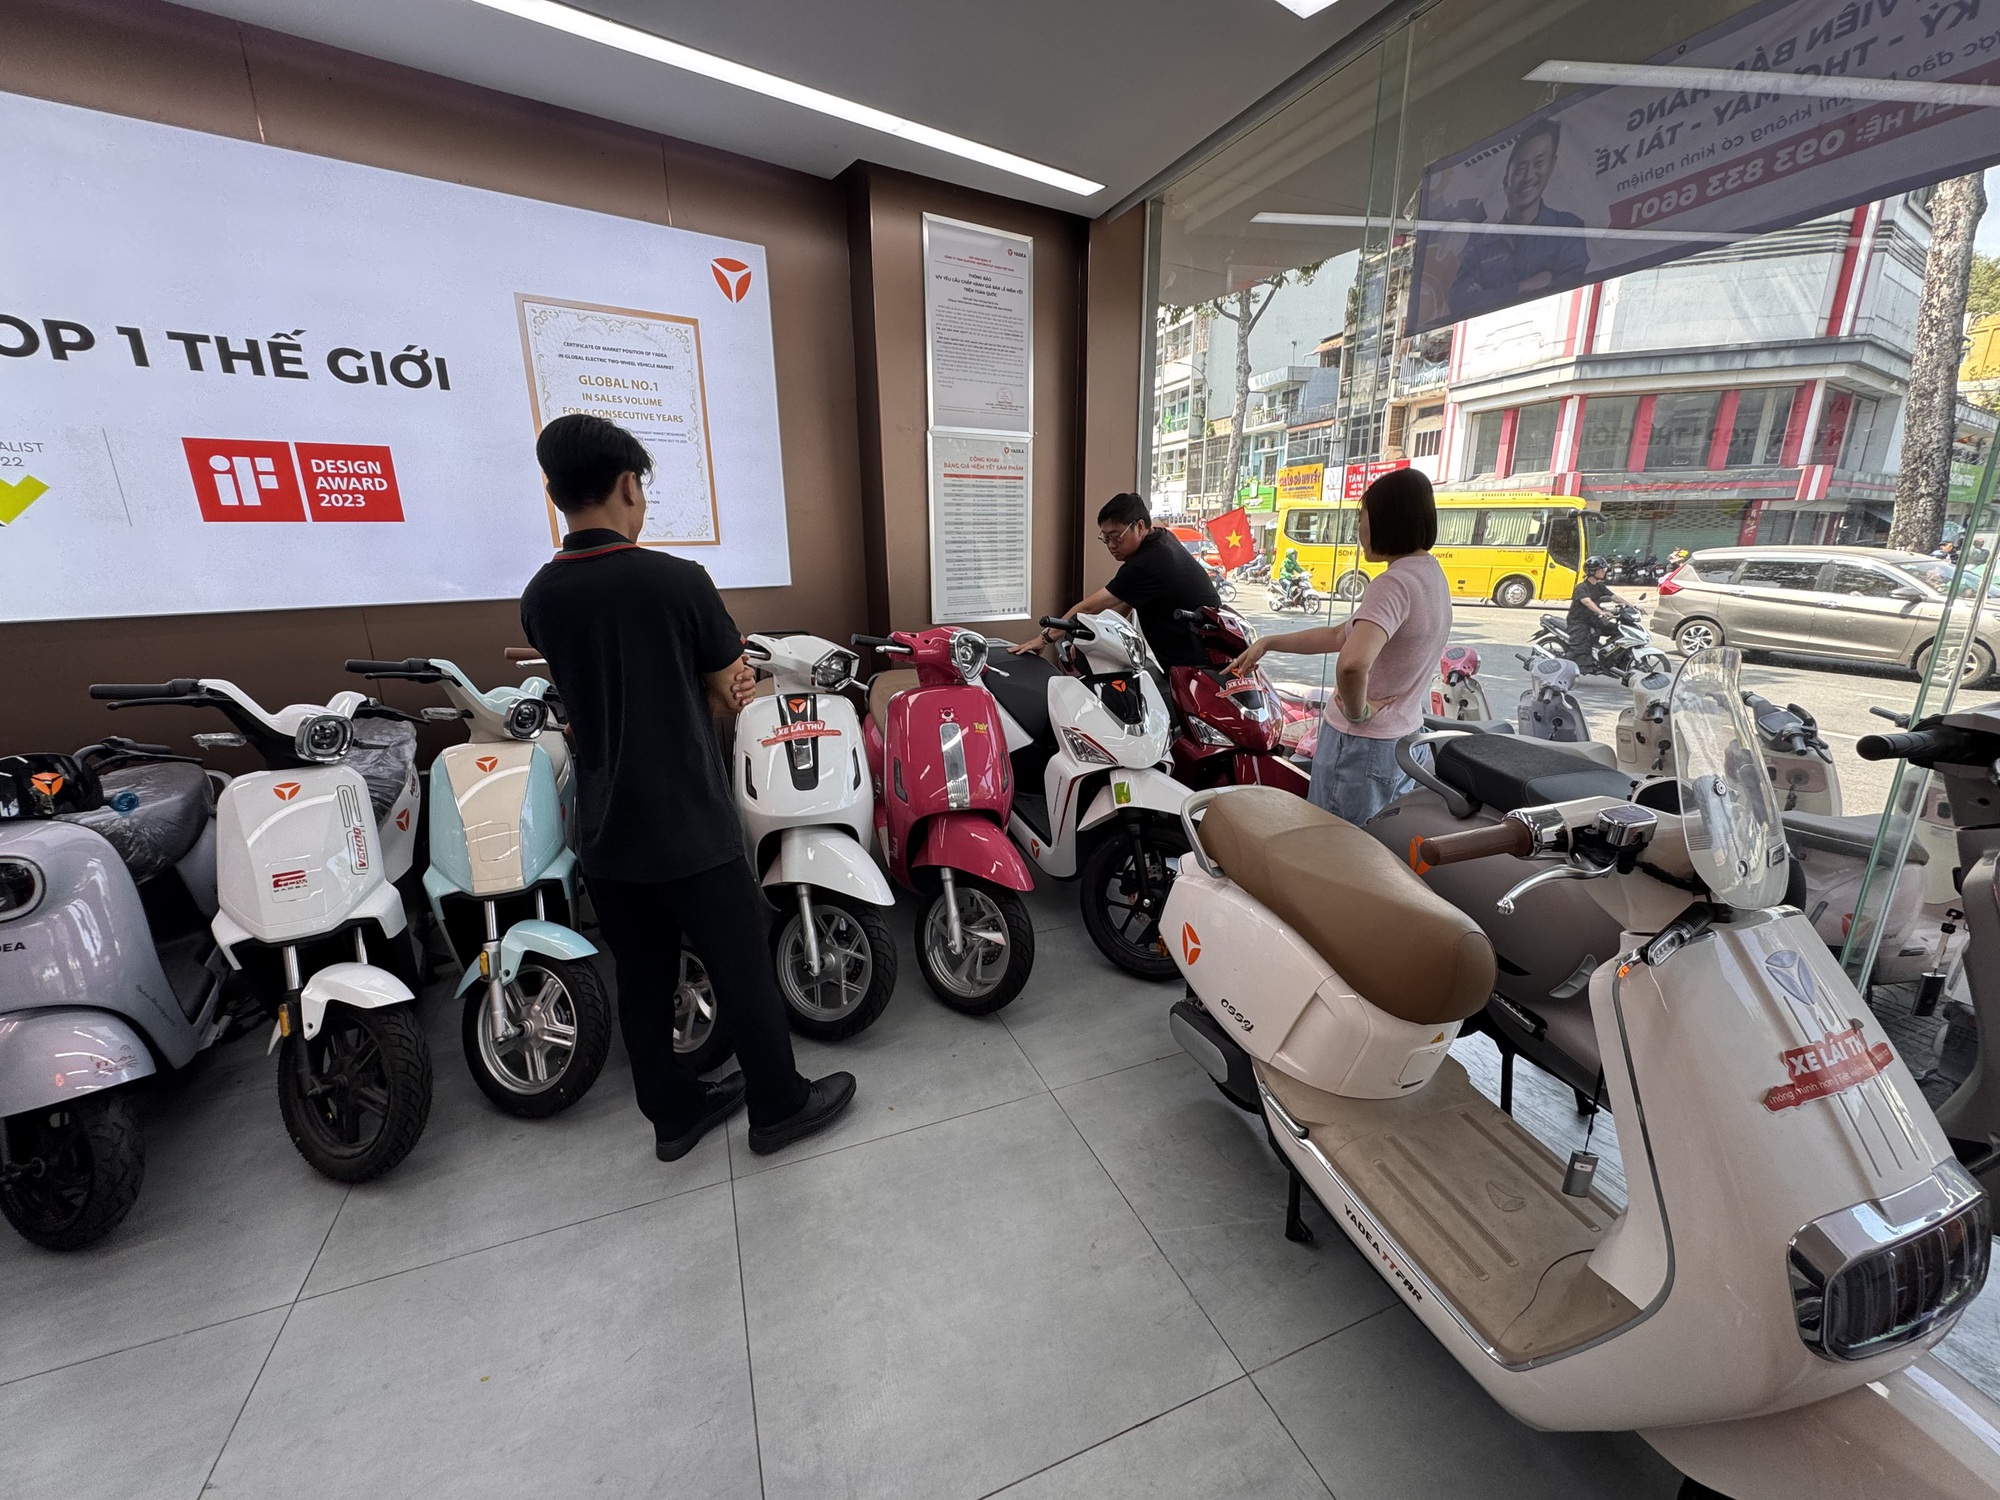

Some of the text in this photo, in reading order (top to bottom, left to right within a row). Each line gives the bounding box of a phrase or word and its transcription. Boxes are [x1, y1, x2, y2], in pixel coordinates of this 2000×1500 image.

[563, 341, 594, 350] CERTIFICATE
[602, 345, 621, 353] MARKET
[622, 348, 645, 356] POSITION
[115, 325, 150, 368] 1
[165, 329, 310, 380] THẾ
[326, 345, 451, 391] GIỚI
[565, 353, 585, 361] GLOBAL
[585, 356, 607, 364] ELECTRIC
[608, 358, 637, 367] TWO-WHEEL
[578, 374, 659, 393] GLOBAL NO.1
[582, 393, 663, 407] IN SALES VOLUME
[562, 406, 582, 416] FOR
[592, 408, 655, 421] CONSECUTIVE
[656, 413, 684, 423] YEARS
[310, 458, 382, 475] DESIGN
[316, 476, 388, 491] AWARD
[319, 493, 366, 507] 2023
[777, 727, 789, 735] XE
[790, 723, 805, 732] LÁI
[0, 941, 26, 952] EA
[1788, 1051, 1822, 1077] XE
[1819, 1038, 1849, 1067] LÁI
[1845, 1033, 1866, 1057] TH
[1794, 1082, 1819, 1096] minh
[1344, 1203, 1422, 1303] YADEA TTFAR
